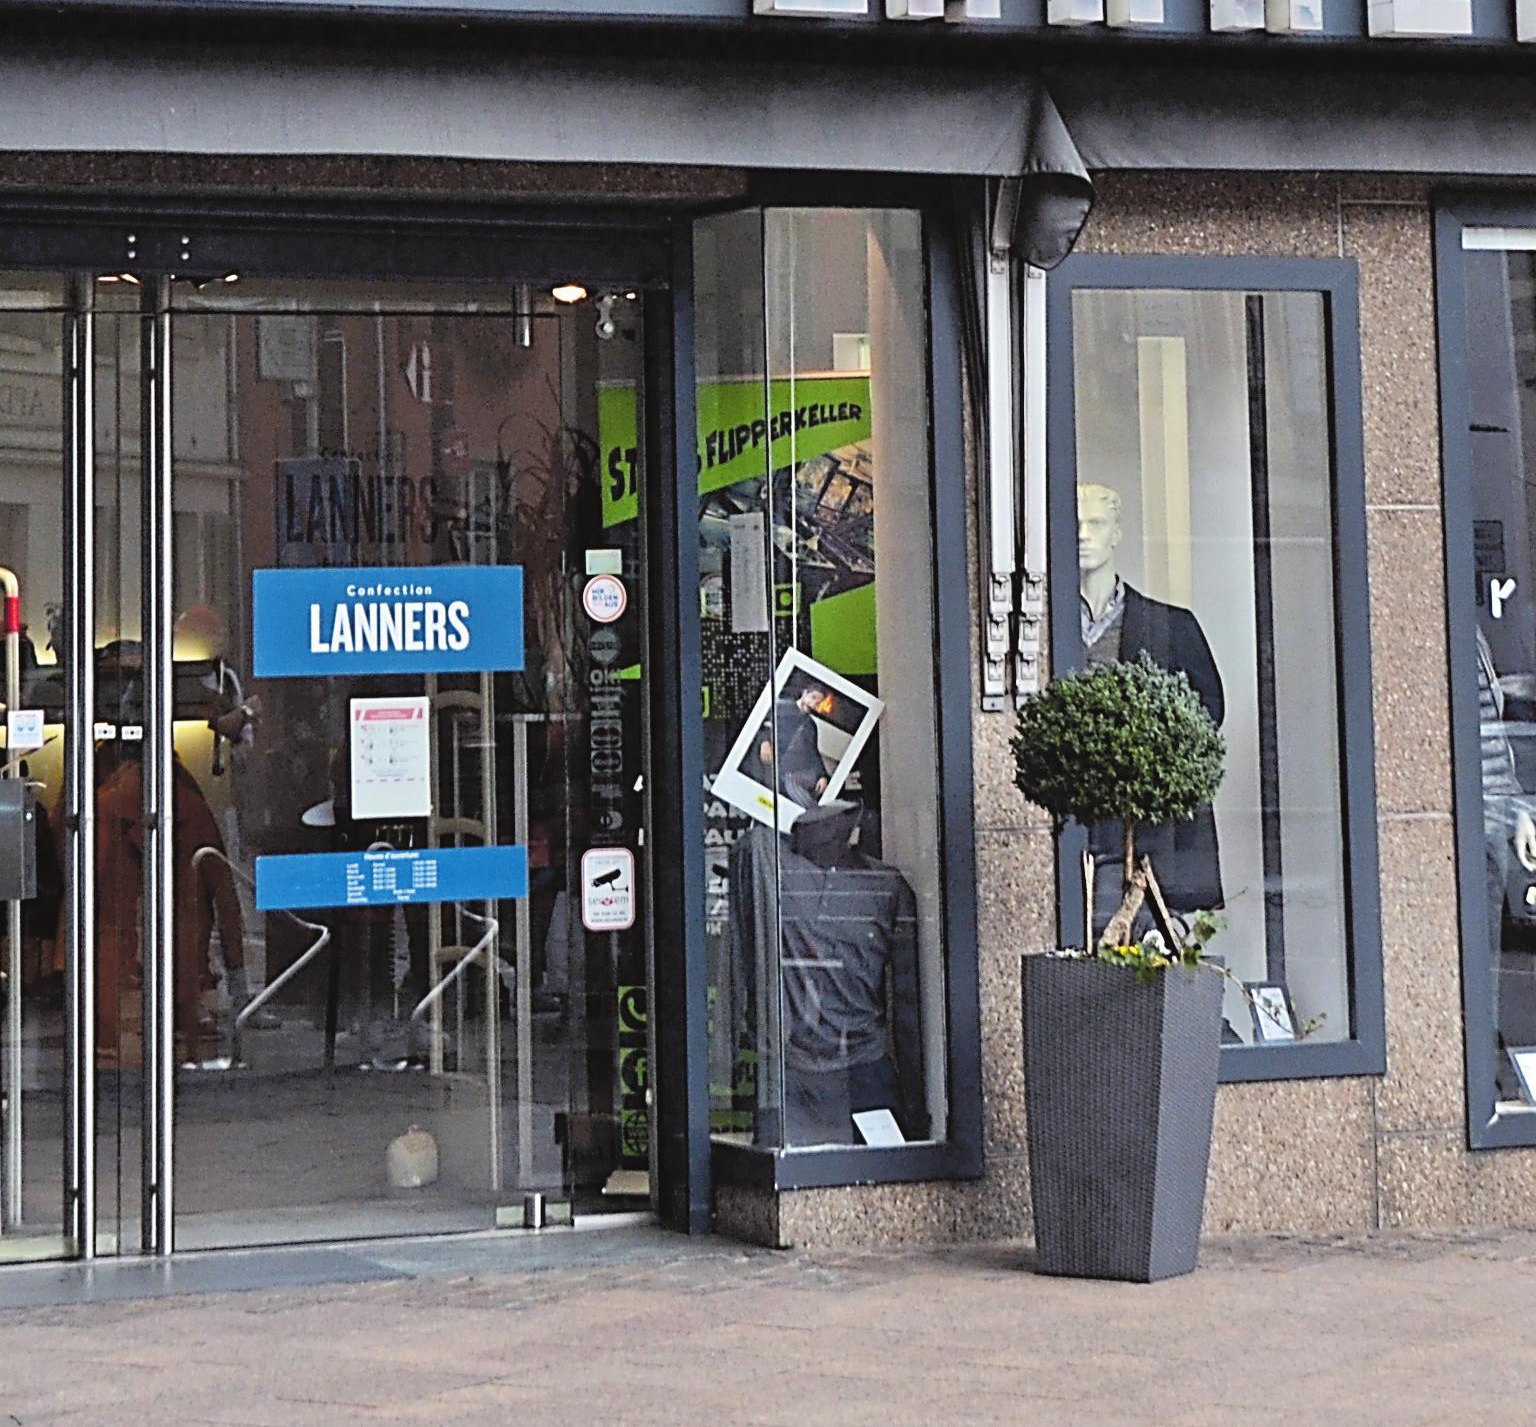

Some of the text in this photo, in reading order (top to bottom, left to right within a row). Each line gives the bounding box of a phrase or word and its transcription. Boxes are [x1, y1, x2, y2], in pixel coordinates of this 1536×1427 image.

[705, 402, 862, 467] FLIPPERKELLER
[346, 582, 433, 598] Confection
[309, 601, 471, 653] LANNERS
